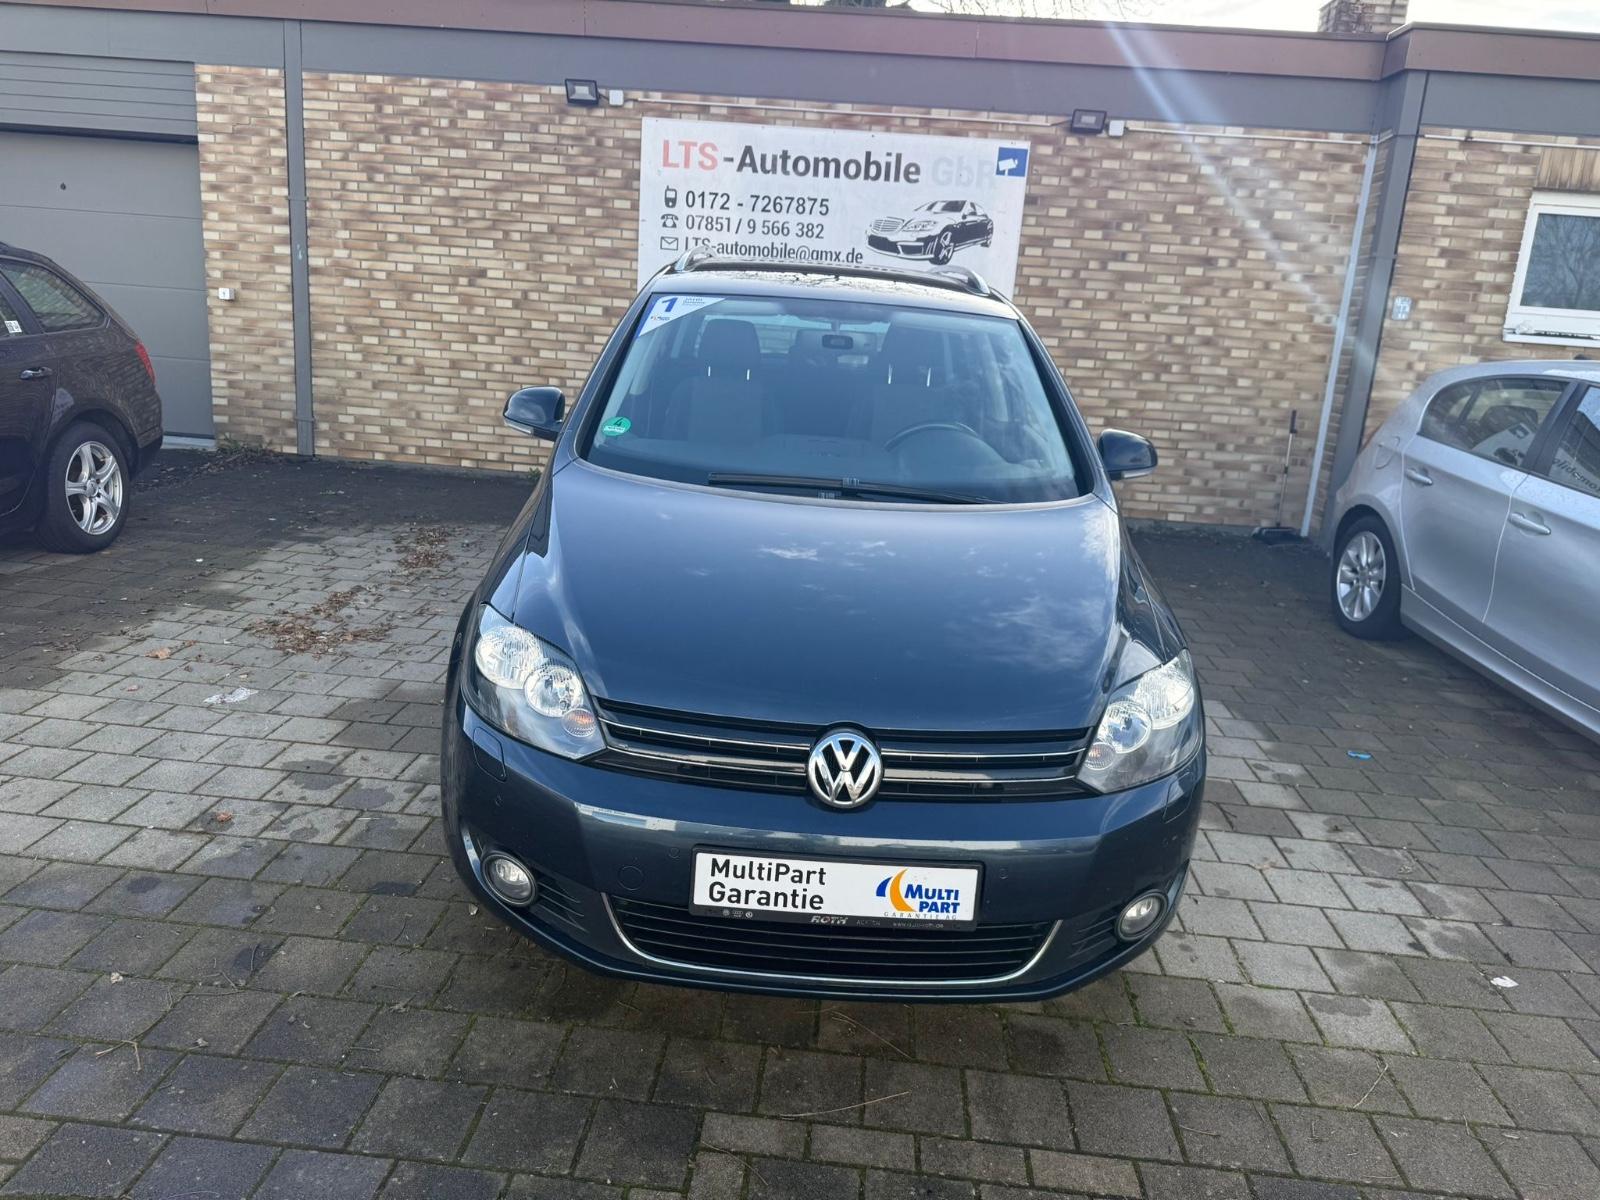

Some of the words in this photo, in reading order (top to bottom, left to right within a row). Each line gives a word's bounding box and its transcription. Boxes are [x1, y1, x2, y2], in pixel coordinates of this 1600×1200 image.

[685, 190, 731, 210] 0172
[750, 194, 830, 216] 7267875
[685, 214, 731, 233] 07851
[747, 218, 757, 234] 9
[761, 220, 791, 237] 566
[795, 222, 825, 239] 382
[661, 297, 678, 312] 1
[710, 857, 827, 886] MultiPart
[708, 881, 824, 911] Garantie
[904, 883, 960, 901] MULTI
[918, 900, 960, 914] PART
[810, 915, 849, 925] ROTH
